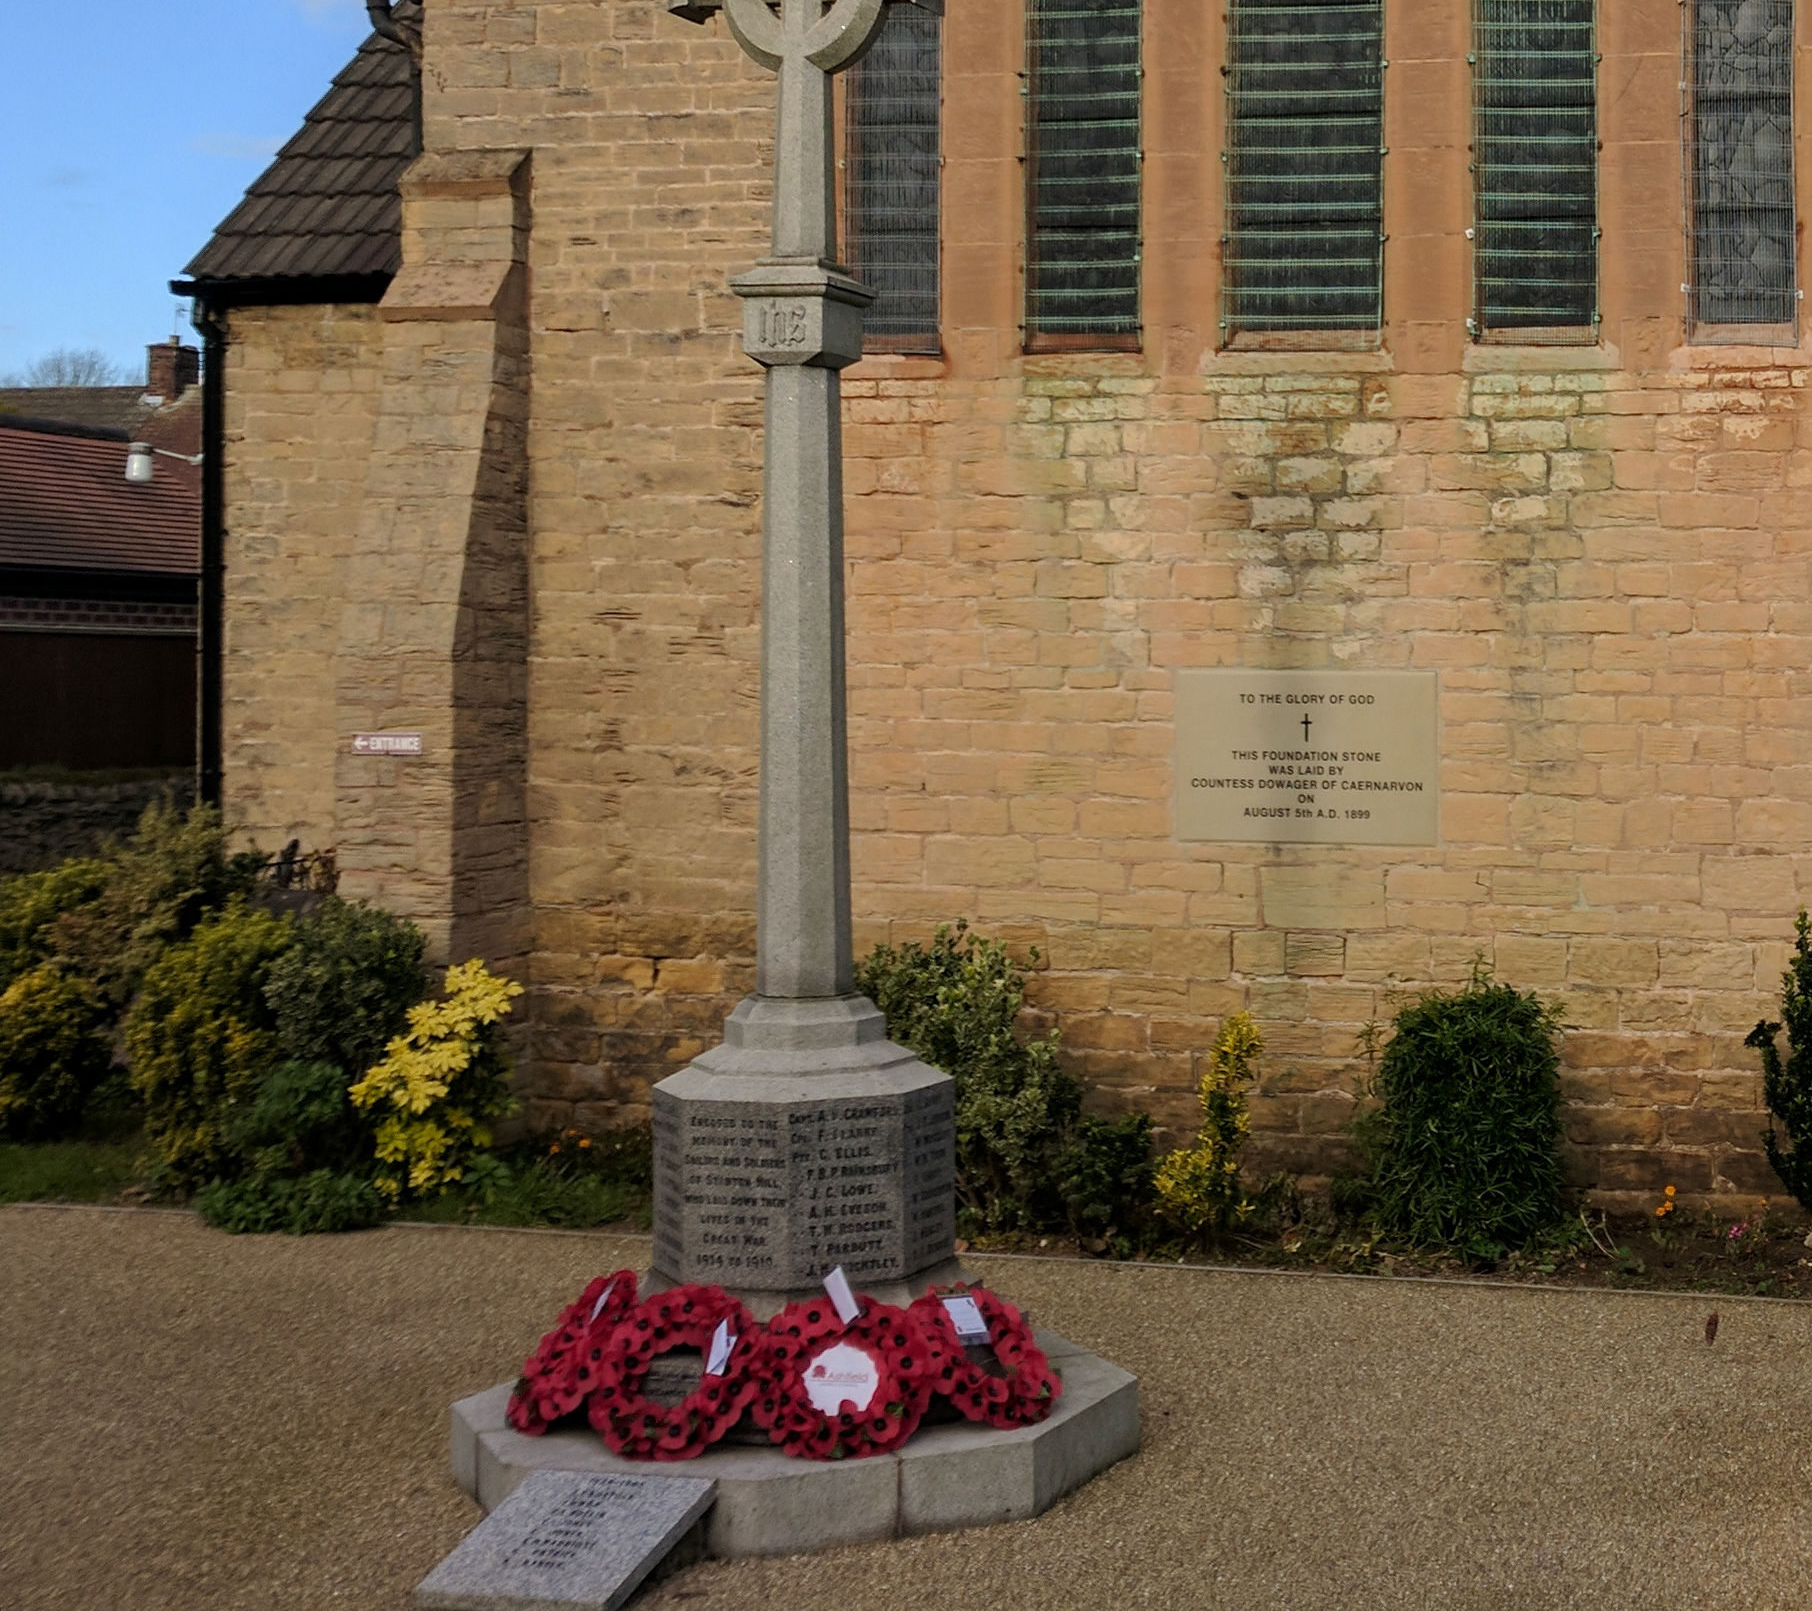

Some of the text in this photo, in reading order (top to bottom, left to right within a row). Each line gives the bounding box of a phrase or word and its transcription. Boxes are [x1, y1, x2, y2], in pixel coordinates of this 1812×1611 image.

[1240, 694, 1375, 705] TO THE GLORY OF GOD
[370, 737, 420, 750] ENTRANCE
[1232, 750, 1381, 762] THIS FOUNDATION STONE
[1269, 765, 1344, 776] WAS LAID BY
[1191, 778, 1423, 791] COUNTESS DOWAGER OF CAERNARVON
[1297, 794, 1314, 804] ON
[1243, 808, 1370, 820] AUGUST 5th A.D. 1899
[759, 1120, 778, 1130] THE
[741, 1137, 753, 1147] OF
[758, 1138, 777, 1148] THE
[723, 1157, 740, 1166] AND
[731, 1196, 757, 1206] DOWN
[700, 1215, 730, 1224] LIVES
[750, 1215, 769, 1226] THE
[703, 1234, 737, 1244] GREAT
